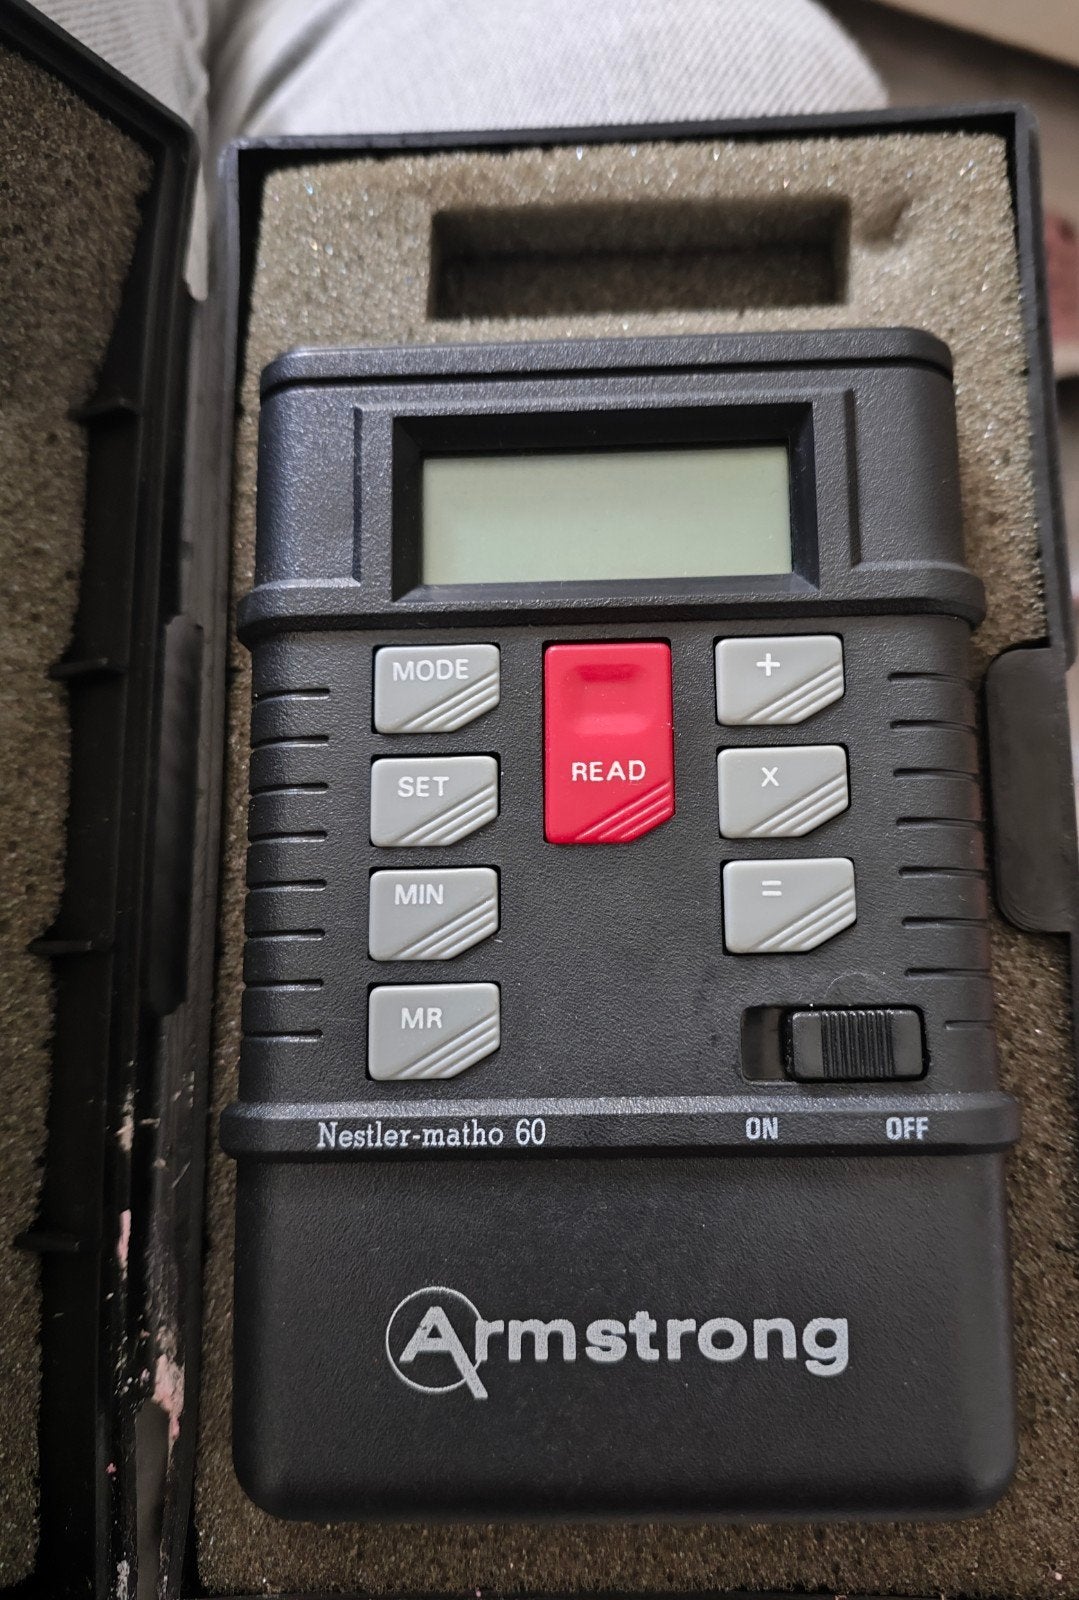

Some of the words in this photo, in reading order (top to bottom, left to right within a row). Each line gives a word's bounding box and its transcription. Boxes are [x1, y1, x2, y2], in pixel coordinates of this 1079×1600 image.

[392, 658, 470, 682] MODE
[571, 759, 647, 783] READ
[397, 776, 450, 798] SET
[394, 883, 444, 905] MIN
[401, 1008, 443, 1029] MR
[316, 1119, 504, 1148] Nestler-matho
[515, 1118, 547, 1146] 60
[745, 1117, 779, 1141] ON
[885, 1116, 930, 1140] OFF
[385, 1286, 849, 1400] Armstrong
